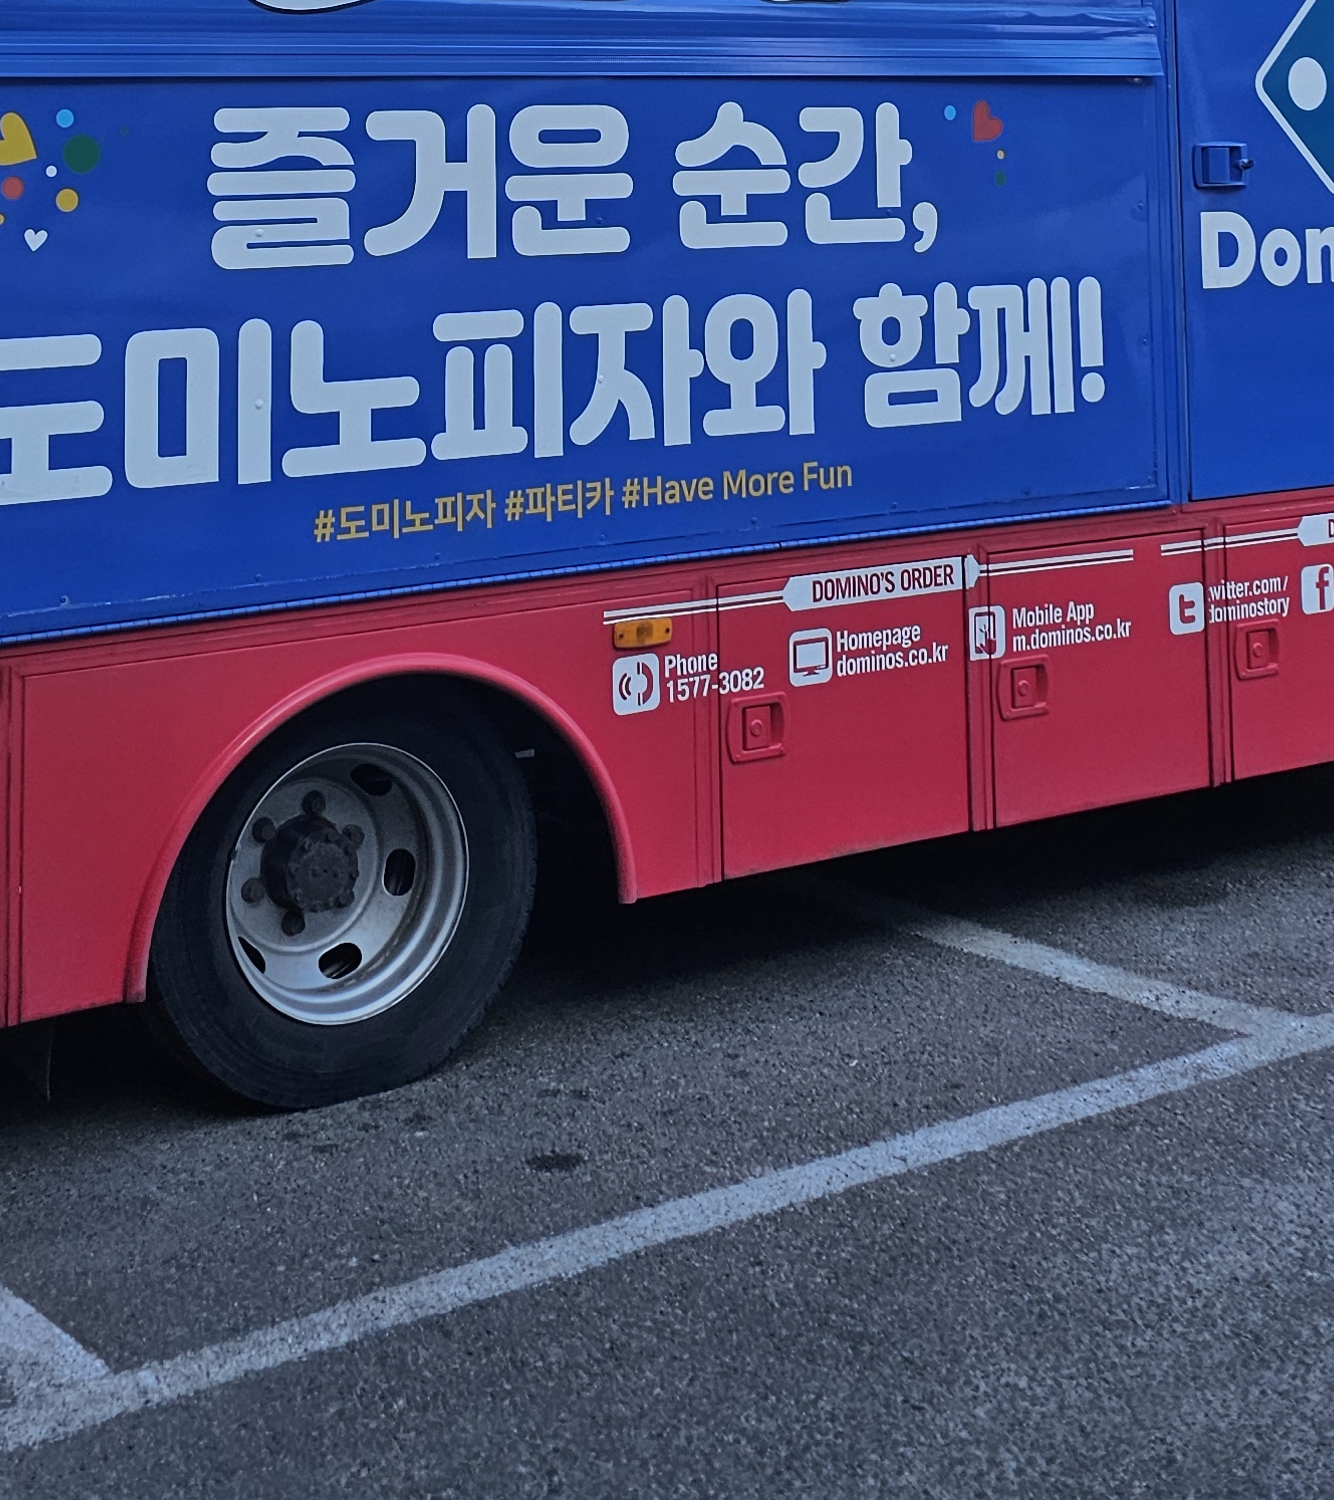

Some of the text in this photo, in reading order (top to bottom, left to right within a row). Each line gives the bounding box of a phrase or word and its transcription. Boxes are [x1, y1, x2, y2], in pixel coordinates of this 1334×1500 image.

[206, 101, 938, 270] 즐거운 순간,
[852, 276, 1106, 428] 함께!
[313, 461, 853, 542] #도미노피자 #파티카 #Have More Fun
[812, 564, 955, 603] DOMINO'S ORDER
[1208, 576, 1289, 602] witter.com/
[1012, 601, 1095, 629] Mobile App
[836, 624, 921, 652] Homepage
[1012, 618, 1132, 652] m.dominos.co.kr
[664, 653, 718, 678] Phone
[836, 642, 949, 677] dominos.co.kr
[667, 667, 765, 703] 1577-3082
